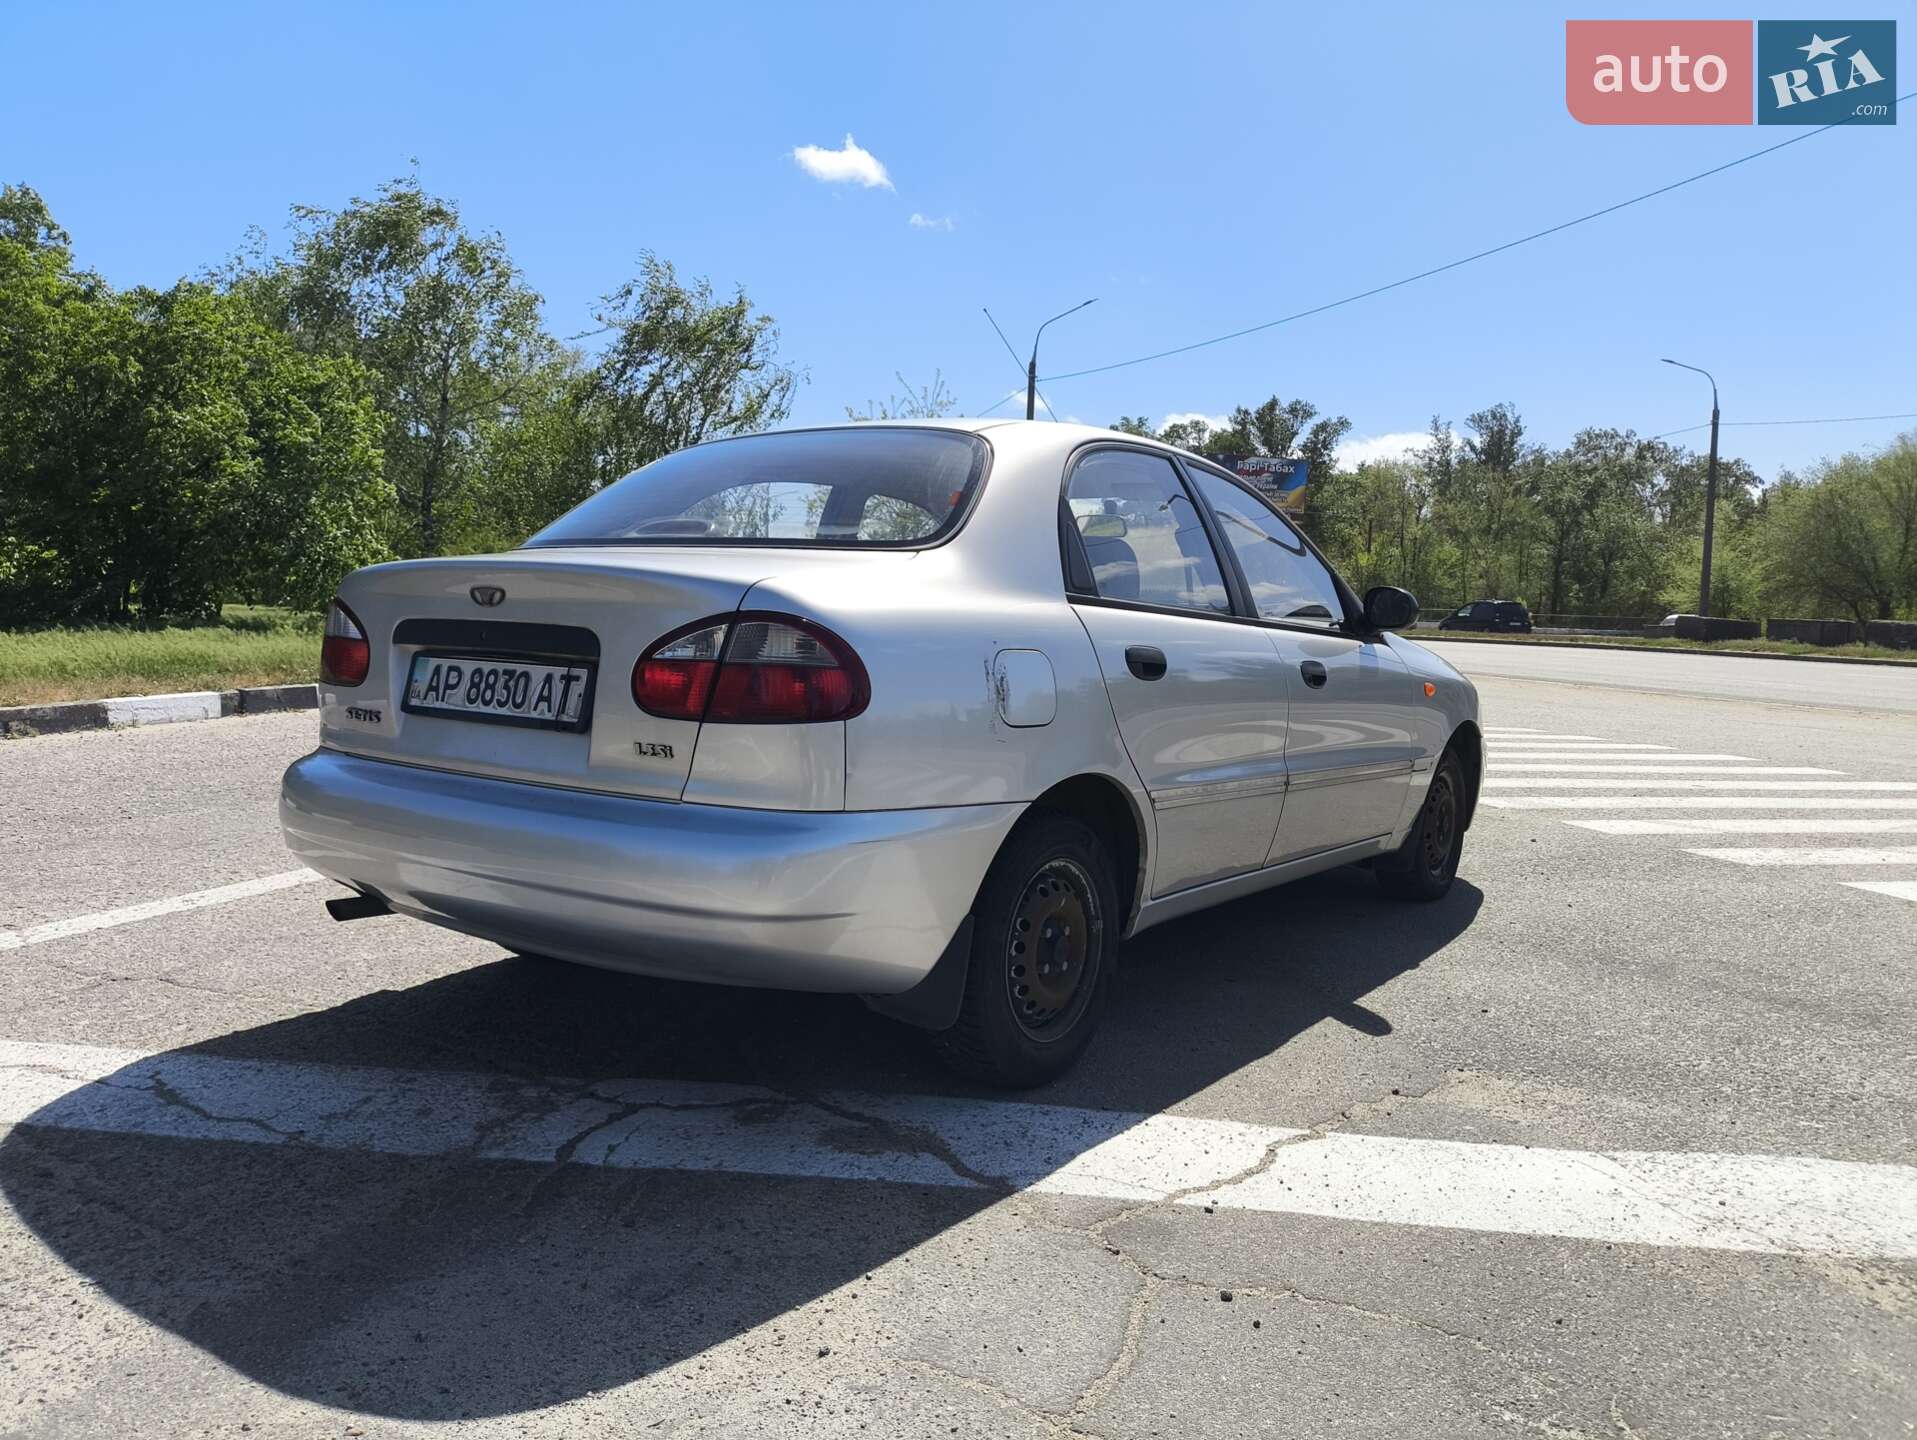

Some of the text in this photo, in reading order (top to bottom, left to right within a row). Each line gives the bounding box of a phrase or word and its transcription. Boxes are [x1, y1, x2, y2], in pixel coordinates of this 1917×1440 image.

[424, 664, 582, 715] AP 8830 AT
